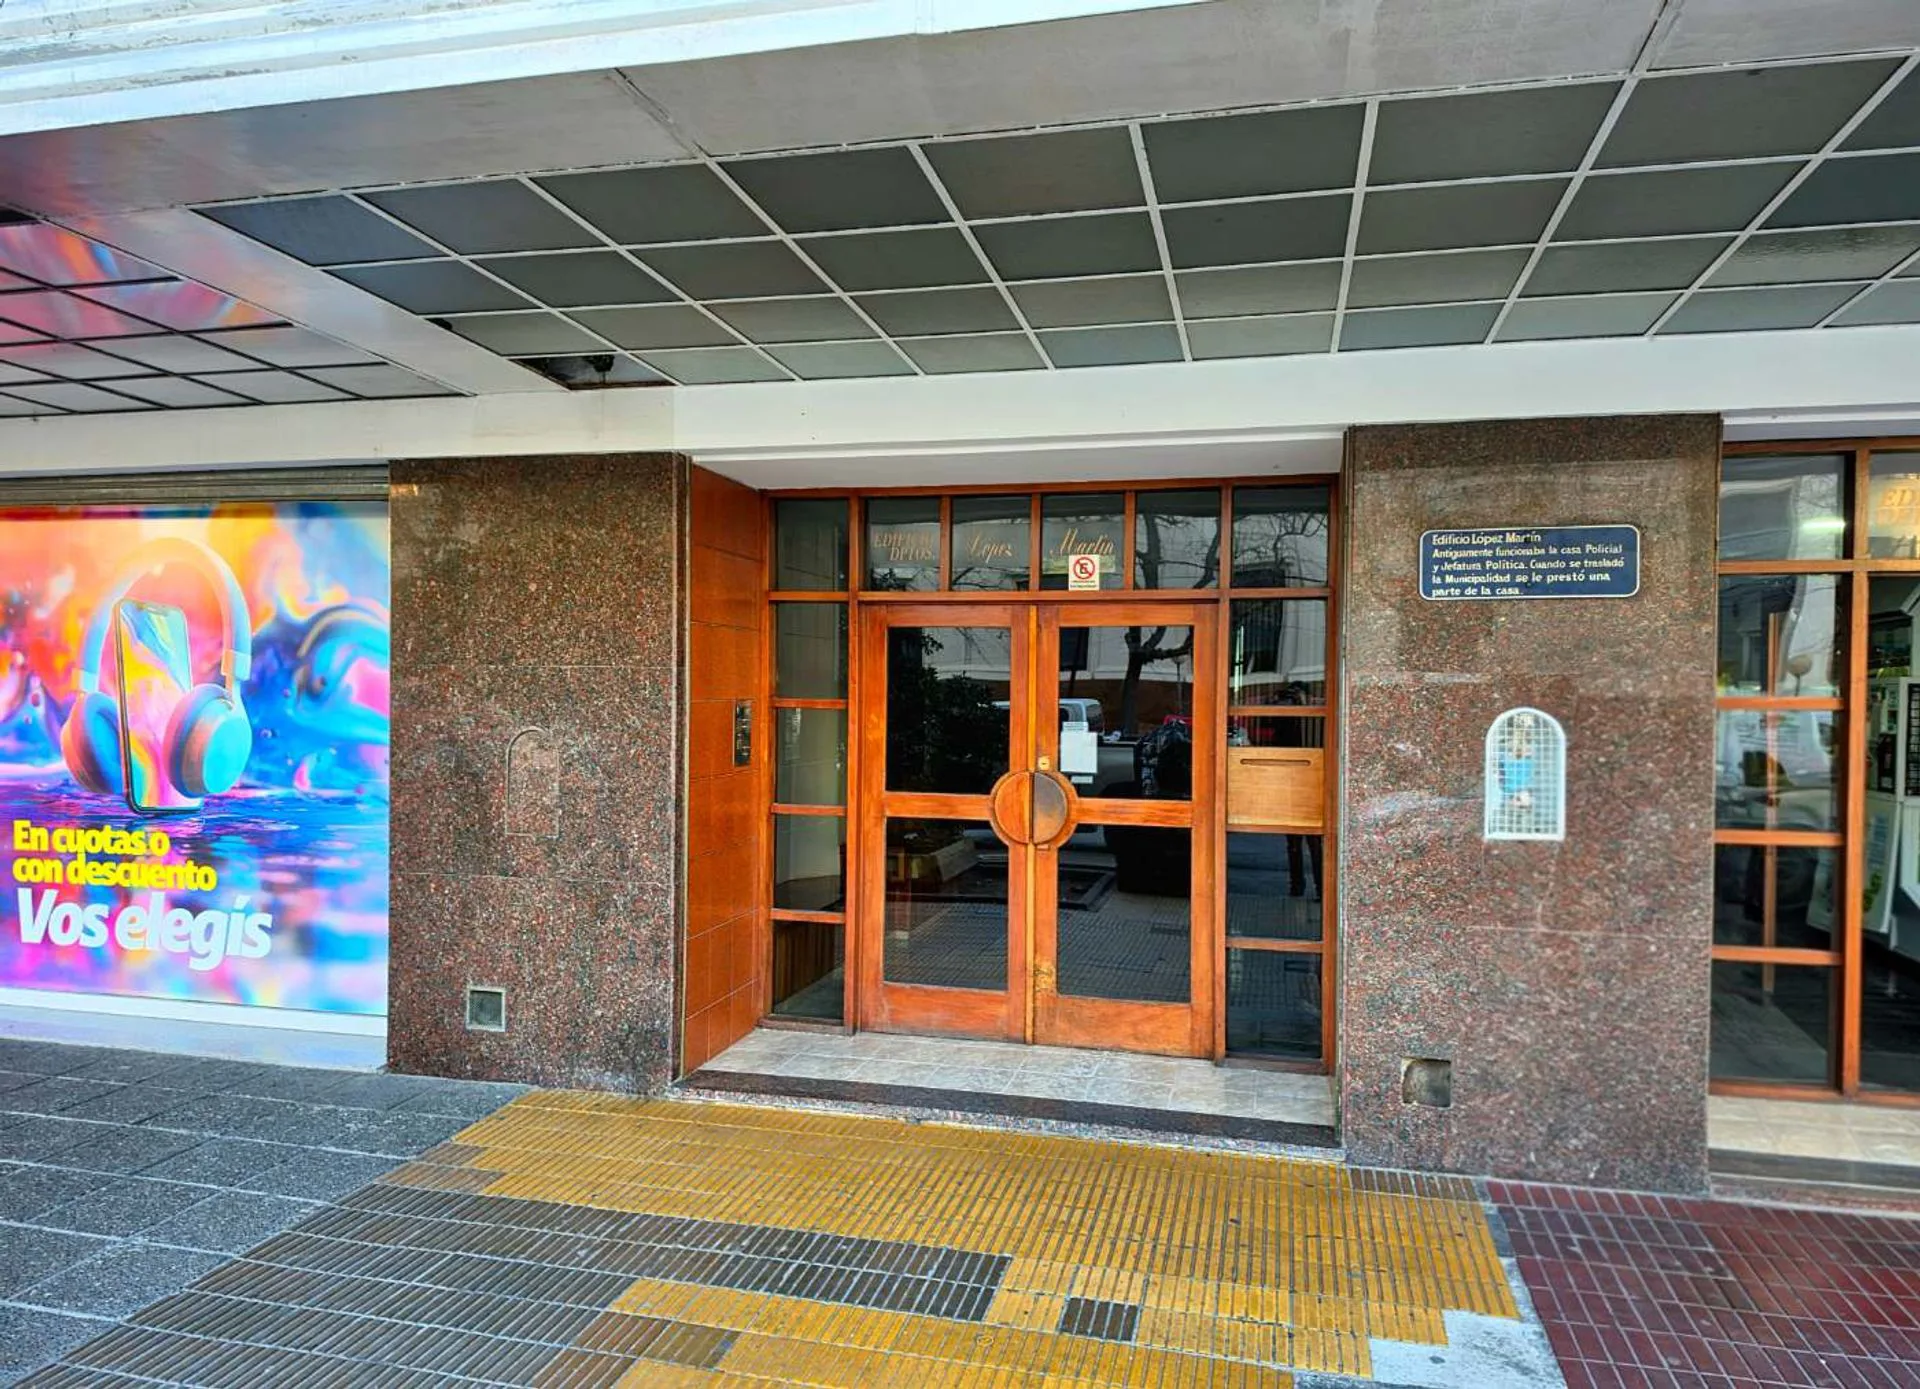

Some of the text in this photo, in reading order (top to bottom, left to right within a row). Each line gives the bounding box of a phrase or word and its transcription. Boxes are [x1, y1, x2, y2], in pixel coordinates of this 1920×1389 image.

[1432, 530, 1541, 545] Edificio López Martín
[1432, 547, 1493, 560] Antiguamente
[1496, 545, 1545, 557] funcionaba
[1548, 545, 1558, 554] la
[1585, 543, 1623, 554] Policial
[1432, 565, 1439, 573] y
[1441, 561, 1481, 571] Jefatura
[1530, 559, 1566, 569] Cuando
[1583, 556, 1625, 568] trasladó
[1432, 569, 1611, 585] la Municipalidad se le prestó una
[1432, 587, 1461, 597] parte
[1465, 587, 1478, 595] de
[1481, 585, 1491, 595] la
[12, 819, 171, 858] En cuotas o
[12, 852, 218, 892] con descuento
[16, 887, 273, 971] Vos elegís
